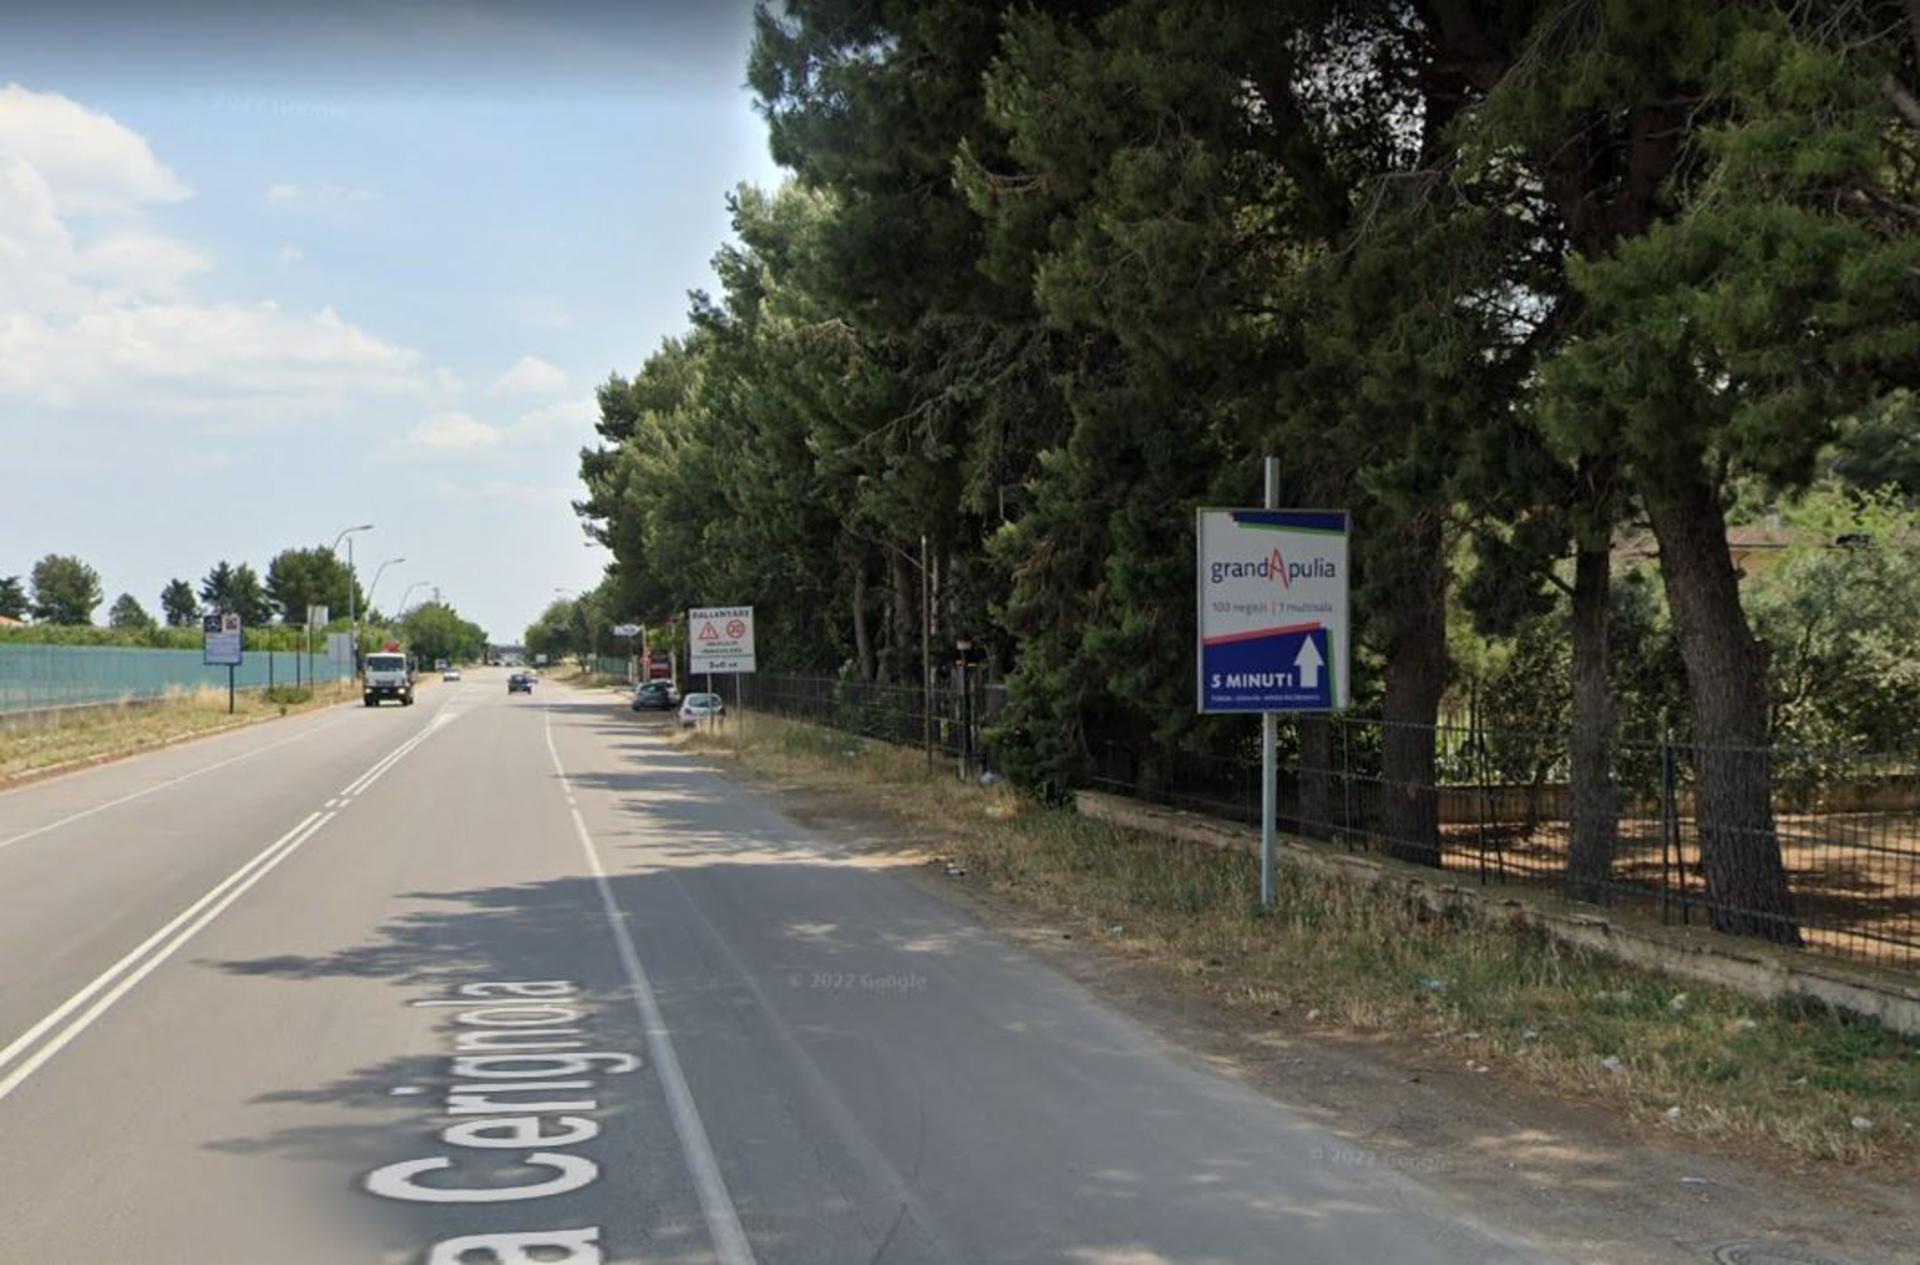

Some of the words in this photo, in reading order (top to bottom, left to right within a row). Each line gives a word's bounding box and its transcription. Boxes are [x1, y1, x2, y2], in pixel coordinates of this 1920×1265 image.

[1211, 547, 1336, 590] grandApulia
[1211, 674, 1222, 688] 5
[1225, 673, 1293, 689] MINUTI
